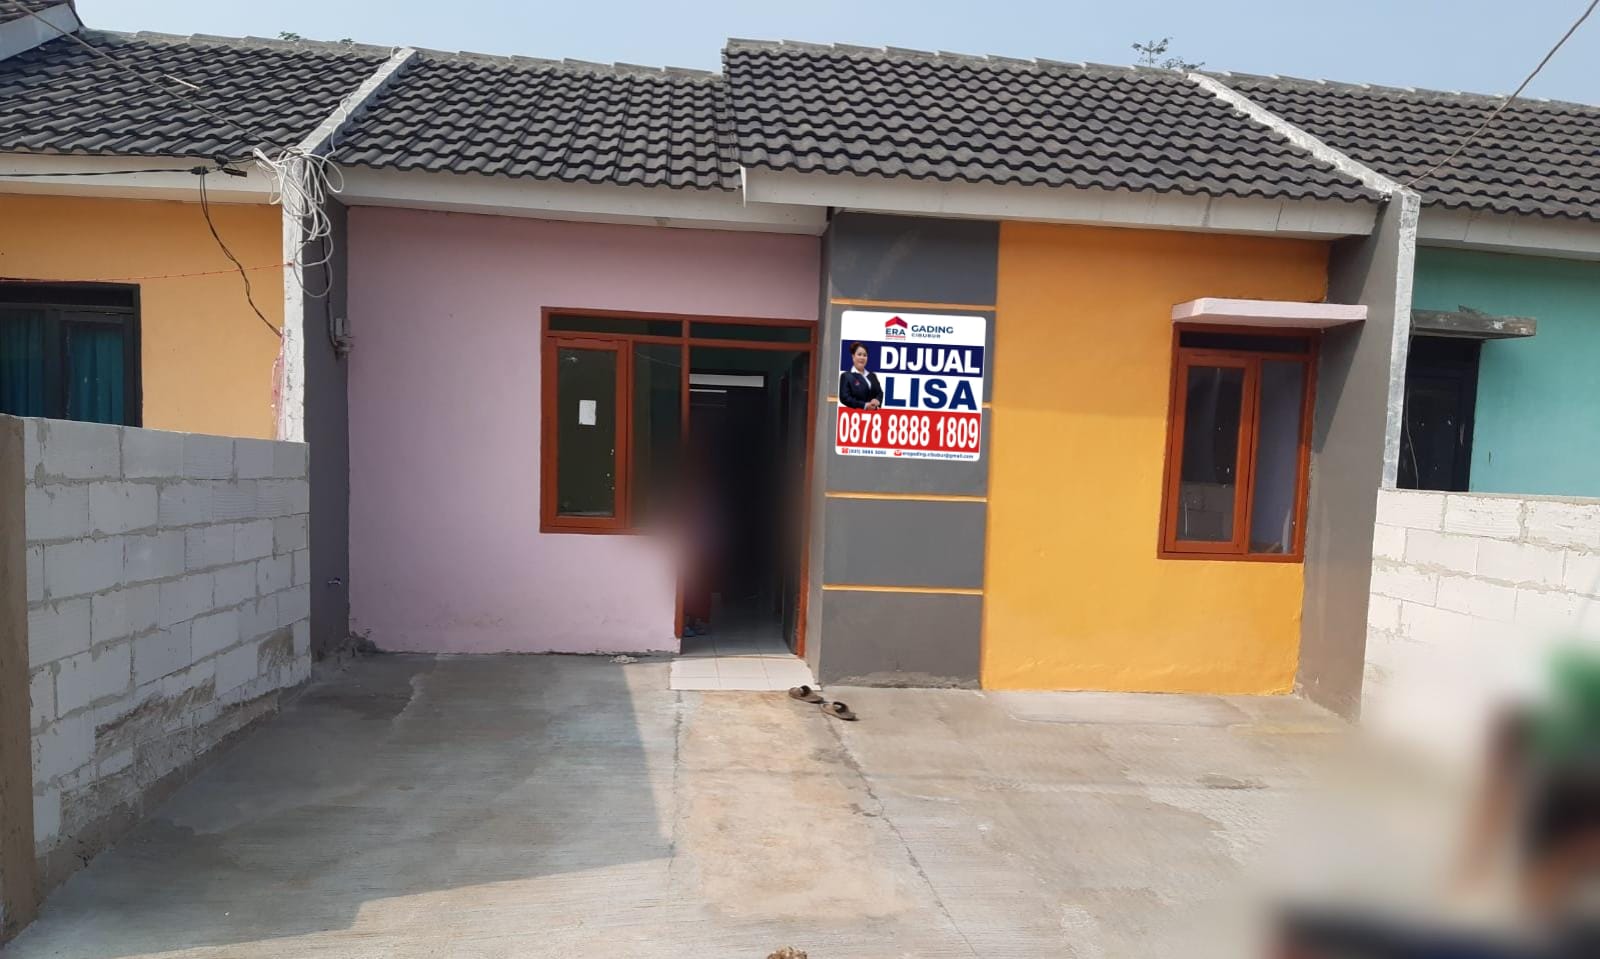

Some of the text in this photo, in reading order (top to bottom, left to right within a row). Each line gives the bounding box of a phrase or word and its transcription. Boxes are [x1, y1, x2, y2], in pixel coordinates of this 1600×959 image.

[885, 328, 906, 336] ERA
[911, 325, 954, 334] GADING
[880, 346, 980, 373] DIJUAL
[884, 376, 977, 411] LISA
[840, 411, 979, 449] 0878 8888 1809
